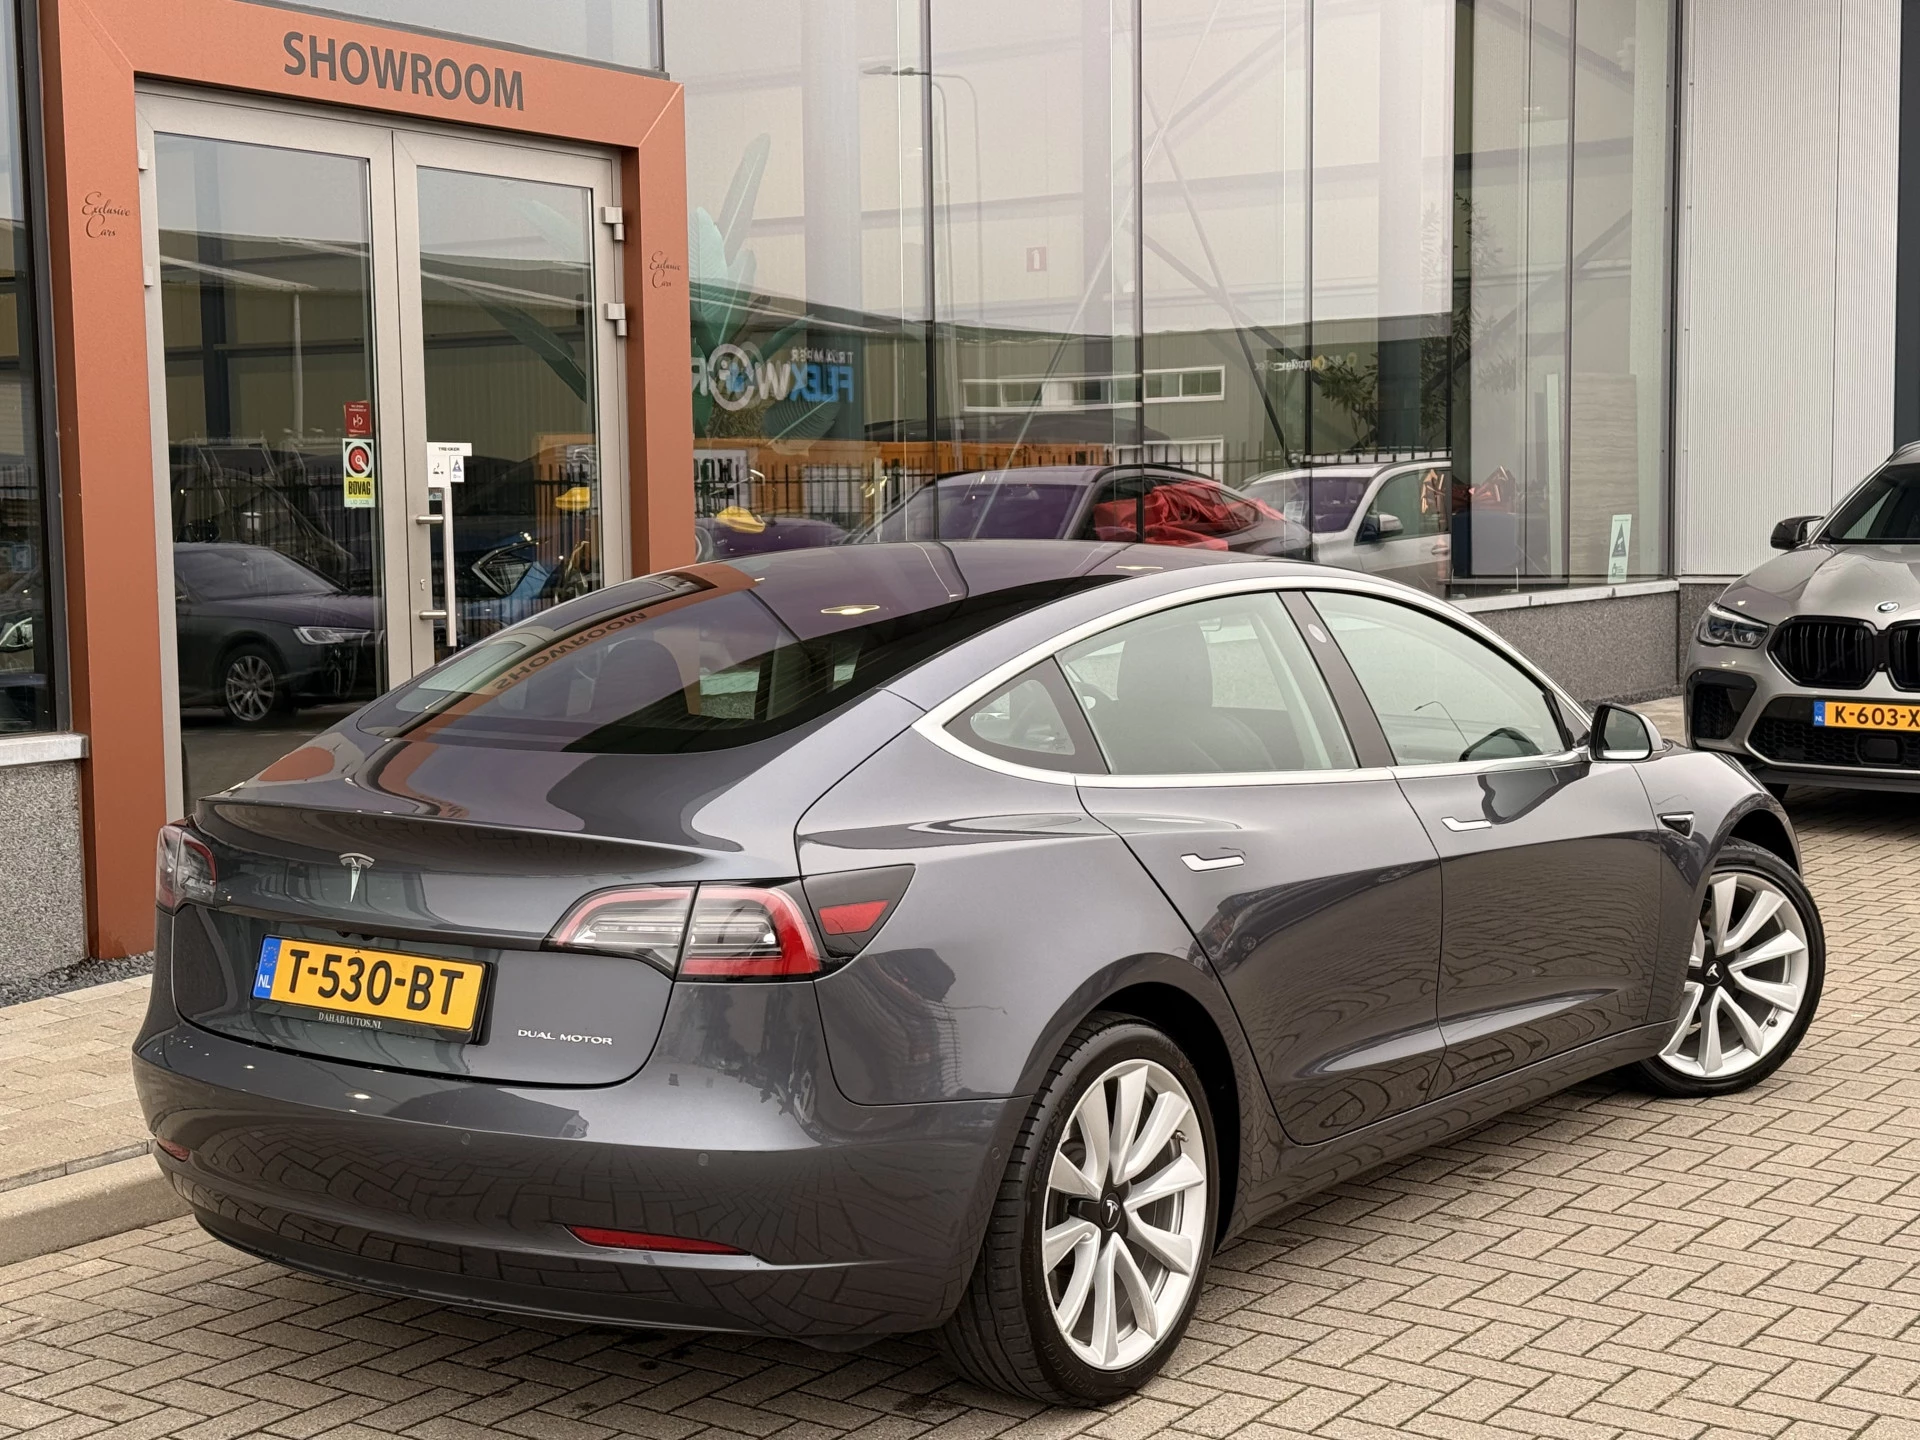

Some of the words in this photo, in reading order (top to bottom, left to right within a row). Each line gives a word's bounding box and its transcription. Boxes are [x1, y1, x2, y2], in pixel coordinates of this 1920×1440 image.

[283, 31, 524, 111] SHOWROOM
[82, 191, 131, 217] Exclusive
[86, 213, 116, 239] Cars
[650, 251, 681, 271] Exclusive
[652, 268, 672, 289] Cars
[348, 481, 371, 496] BOVAG
[1835, 705, 1920, 727] K-603-X
[257, 974, 271, 989] NL
[288, 949, 465, 1015] T-530-BT
[318, 1012, 383, 1030] DAHABAUTOS.NL
[517, 1029, 556, 1040] DUAL
[559, 1033, 613, 1046] MOTOR
